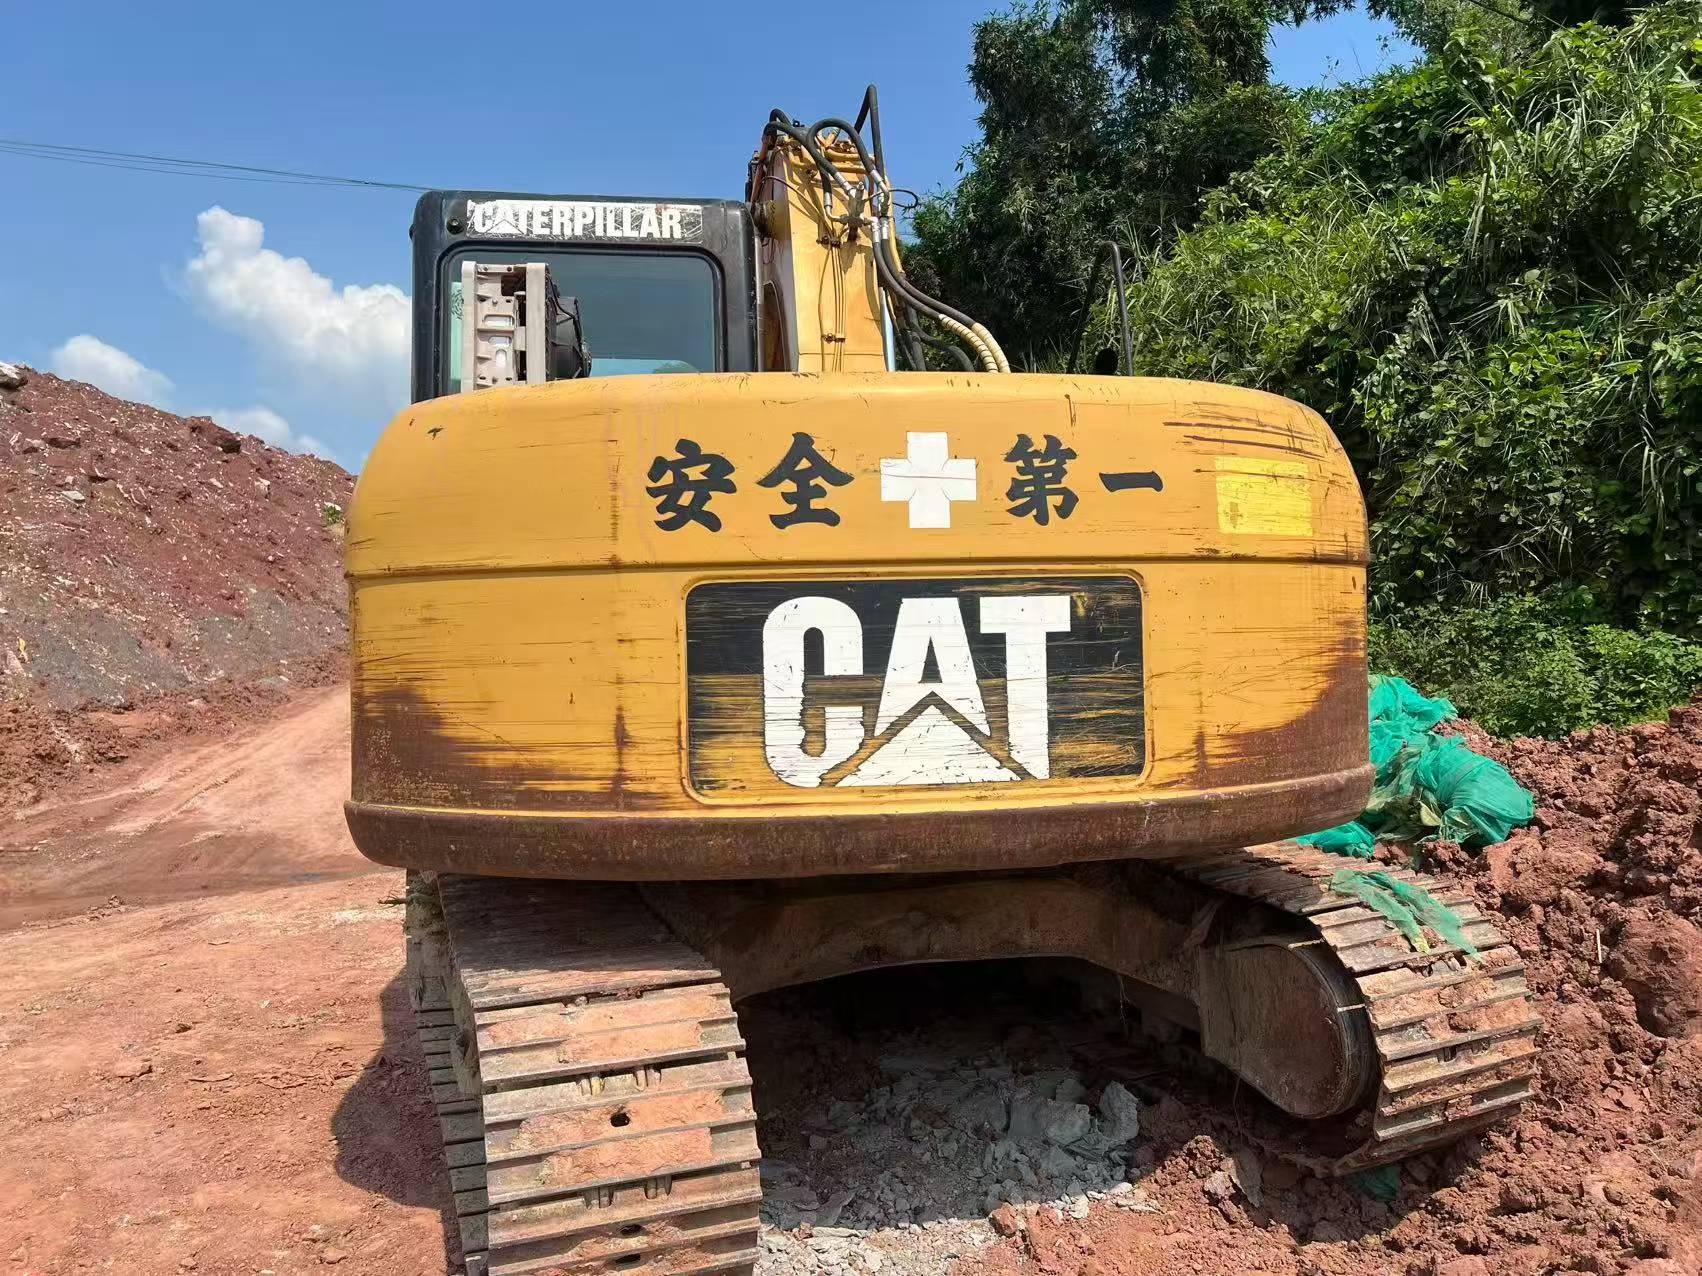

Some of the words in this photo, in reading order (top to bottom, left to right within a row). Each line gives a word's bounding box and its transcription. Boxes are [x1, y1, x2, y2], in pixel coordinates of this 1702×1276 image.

[474, 202, 683, 239] CATERPILLAR
[646, 432, 855, 533] 安全
[1004, 434, 1164, 522] 第一
[762, 596, 1071, 788] CAT
